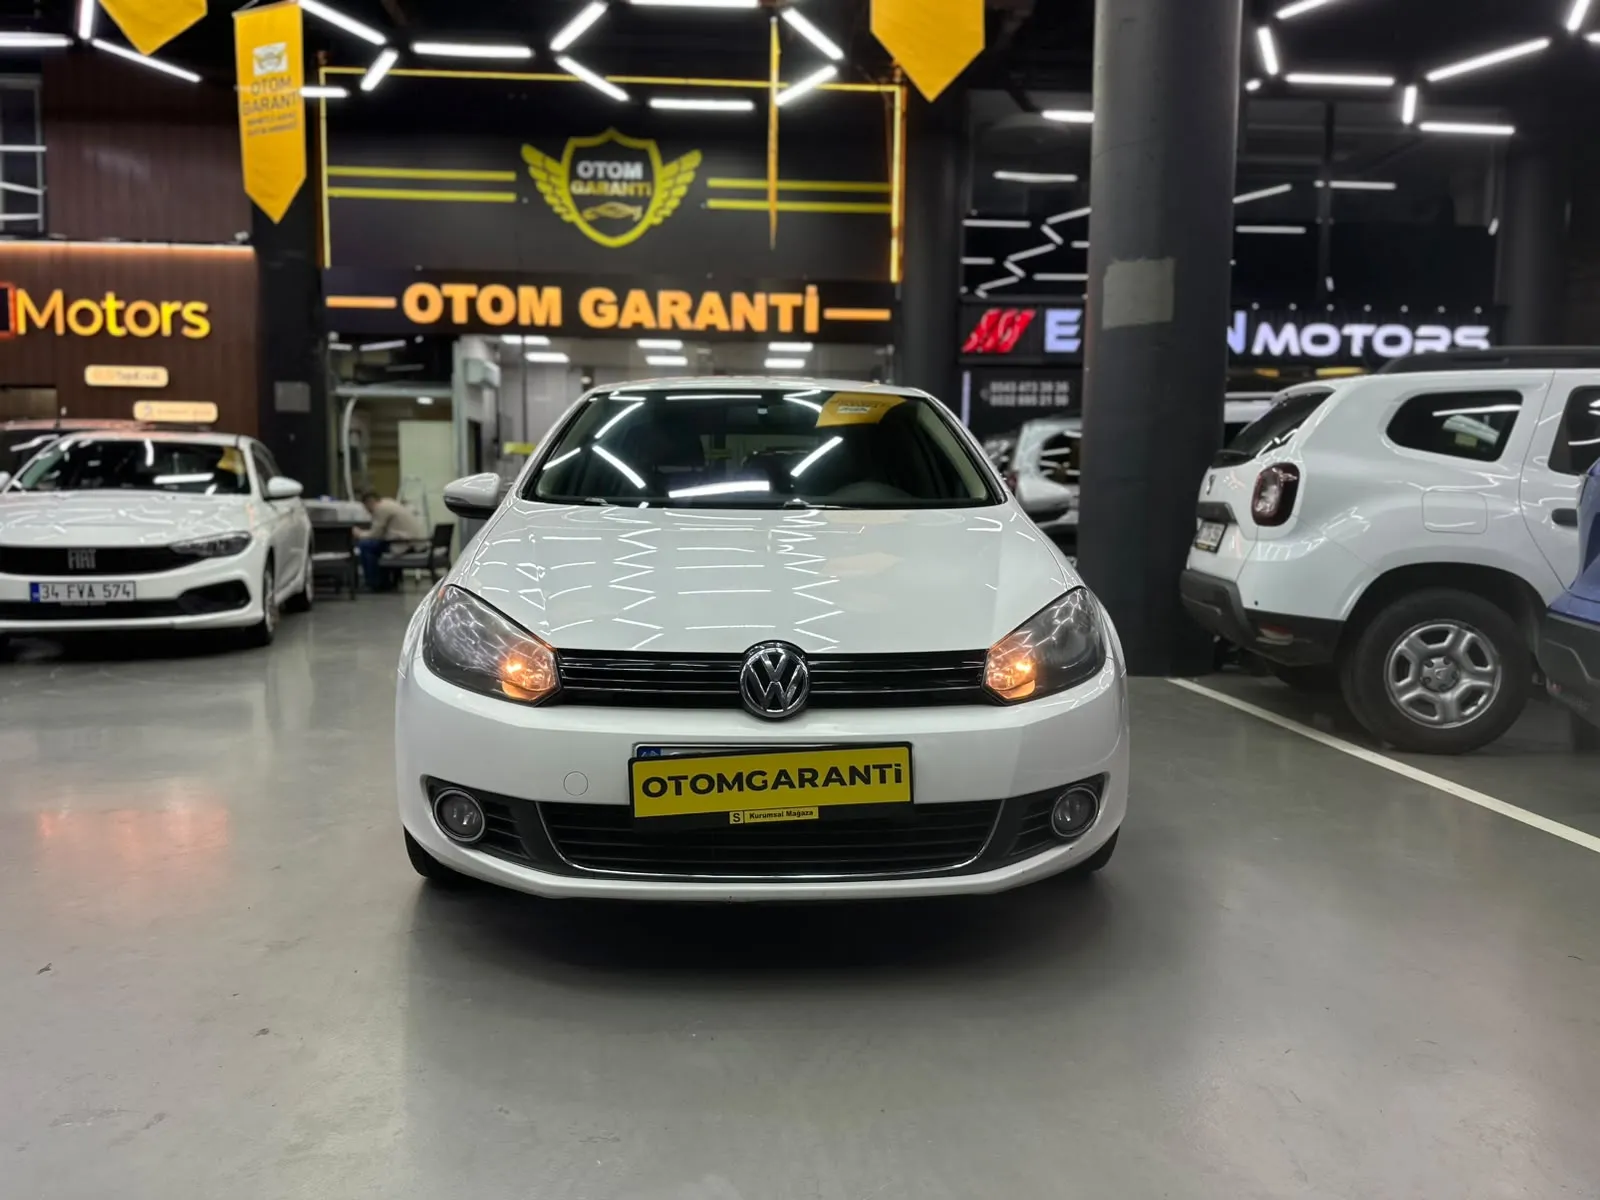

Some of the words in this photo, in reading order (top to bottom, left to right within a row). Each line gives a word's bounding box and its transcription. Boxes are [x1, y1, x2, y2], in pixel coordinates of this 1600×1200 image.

[576, 160, 644, 179] OTOM
[16, 288, 211, 339] Motors
[403, 282, 561, 326] OTOM
[579, 285, 819, 333] GARANTİ
[1251, 322, 1490, 357] MOTORS
[68, 548, 96, 569] FIAT
[42, 584, 59, 599] 34
[67, 584, 95, 599] FVA
[103, 583, 131, 599] 574
[733, 811, 742, 823] S
[749, 811, 784, 820] Kurumsal
[785, 809, 813, 819] Mağaza
